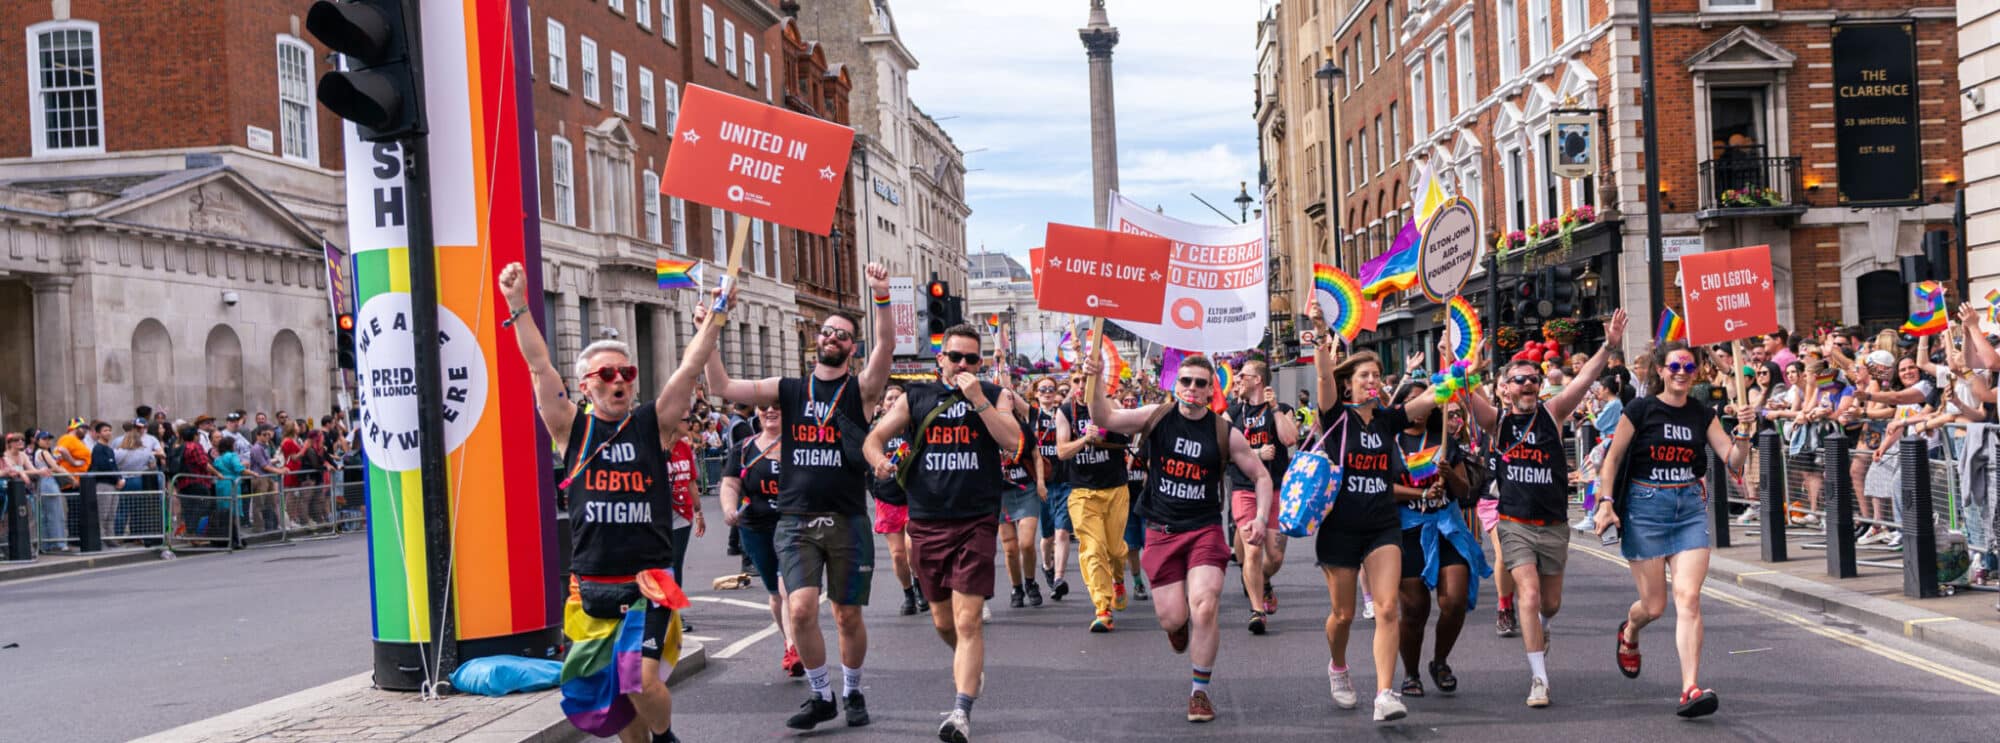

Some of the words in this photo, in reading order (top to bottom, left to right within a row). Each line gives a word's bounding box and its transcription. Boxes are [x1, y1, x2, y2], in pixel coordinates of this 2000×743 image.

[1861, 70, 1887, 81] THE
[1840, 84, 1909, 98] CLARENCE
[1845, 118, 1855, 126] 53
[1858, 116, 1906, 125] WHITEHALL
[719, 120, 784, 154] UNITED
[787, 139, 808, 161] IN
[728, 152, 785, 184] PRIDE
[1429, 234, 1451, 254] ELTON
[1451, 224, 1471, 242] JOHN
[1442, 244, 1459, 260] AIDS
[1066, 257, 1097, 276] LOVE
[1100, 262, 1113, 278] IS
[1116, 264, 1147, 282] LOVE
[1427, 248, 1472, 280] FOUNDATION
[1187, 269, 1218, 289] END
[1700, 273, 1721, 291] END
[1723, 268, 1758, 288] LGBTQ+
[1207, 306, 1228, 315] ELTON
[1228, 305, 1243, 315] JOHN
[1716, 292, 1751, 312] STIGMA
[1206, 316, 1222, 324] AIDS
[1223, 311, 1256, 324] FOUNDATION
[359, 317, 383, 354] WE
[372, 367, 415, 386] PR!D
[373, 386, 382, 398] IN
[383, 385, 417, 398] LONDO
[925, 424, 979, 445] LGBTQ+
[1663, 423, 1693, 441] END
[600, 442, 636, 463] END
[792, 448, 842, 467] STIGMA
[1174, 437, 1202, 458] END
[925, 451, 979, 471] STIGMA
[584, 469, 653, 493] LGBTQ+
[1506, 465, 1553, 484] STIGMA
[1649, 466, 1696, 481] STIGMA
[1159, 477, 1206, 500] STIGMA
[584, 501, 652, 523] STIGMA
